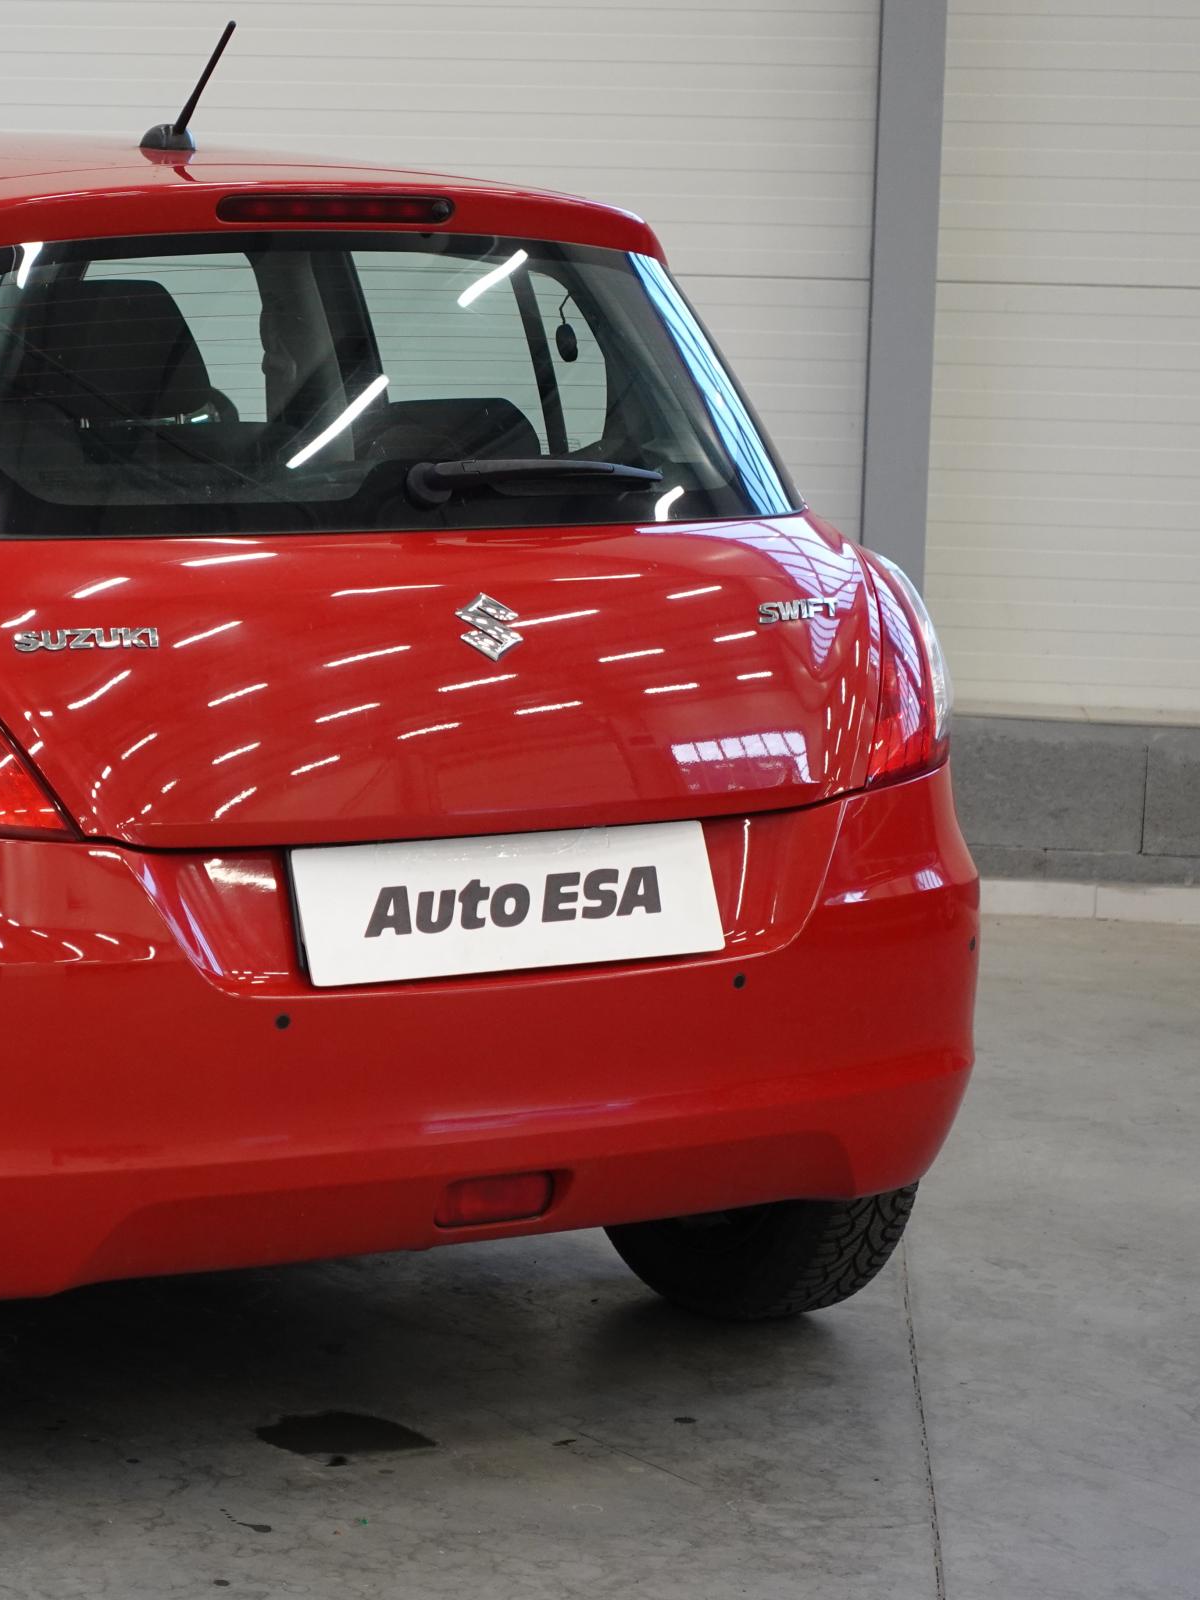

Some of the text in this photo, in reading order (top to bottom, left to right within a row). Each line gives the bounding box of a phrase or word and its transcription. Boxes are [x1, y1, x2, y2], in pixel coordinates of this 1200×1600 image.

[758, 597, 839, 624] SWIFT
[13, 627, 159, 652] SUZUKI
[364, 865, 662, 938] Auto ESA
